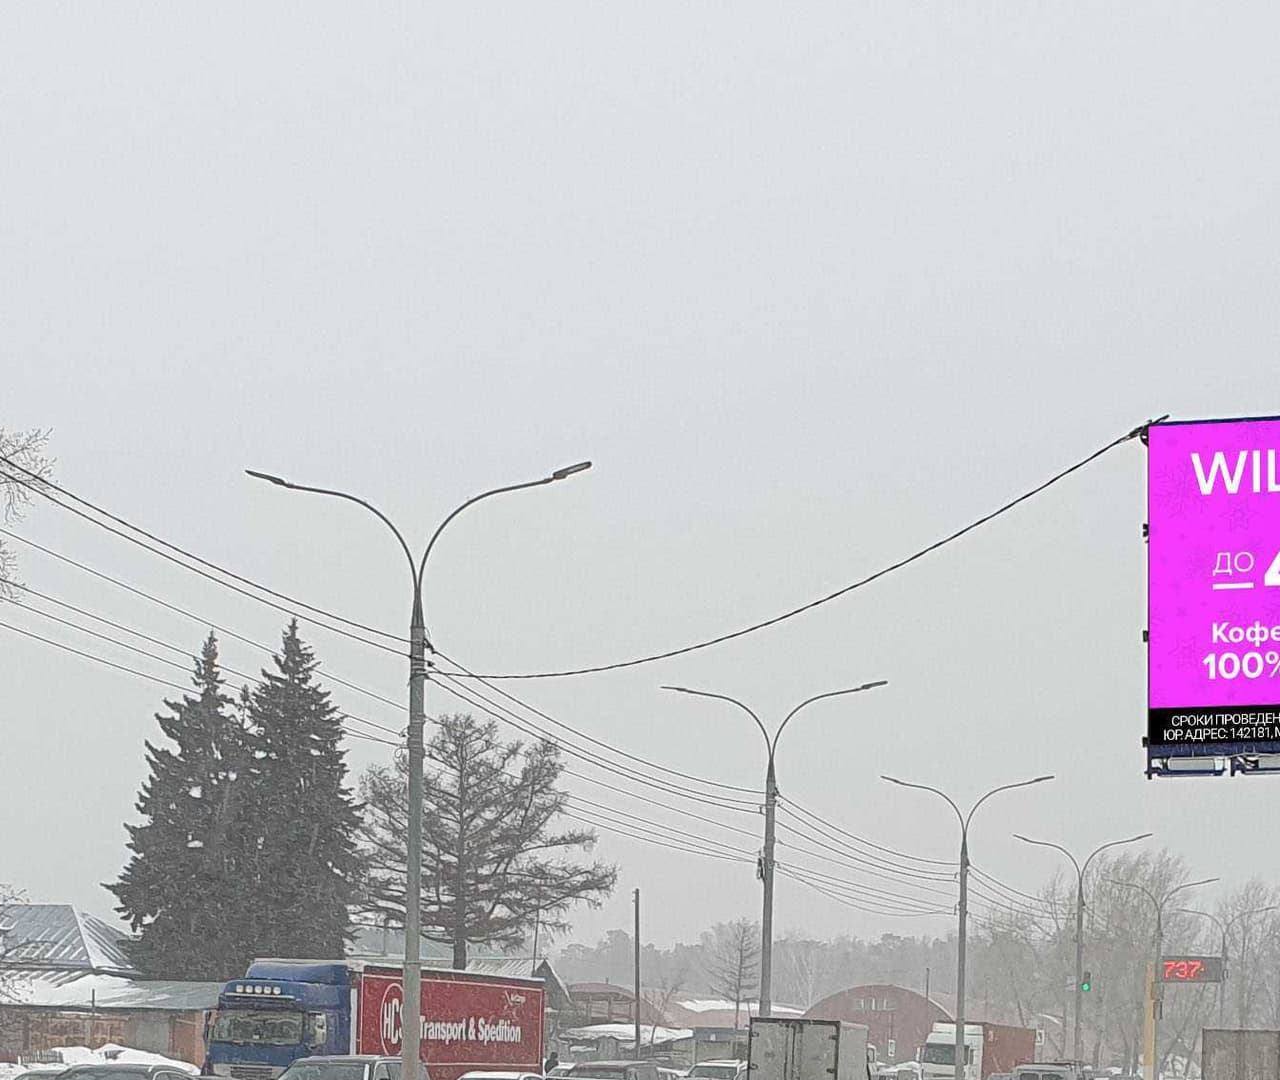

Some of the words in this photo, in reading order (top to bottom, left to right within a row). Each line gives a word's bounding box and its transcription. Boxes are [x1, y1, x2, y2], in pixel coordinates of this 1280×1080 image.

[1171, 714, 1214, 727] СРОКИ
[1230, 726, 1274, 740] 142181,
[420, 1015, 467, 1045] Transport
[468, 1017, 476, 1041] &
[477, 1017, 521, 1046] Spedition
